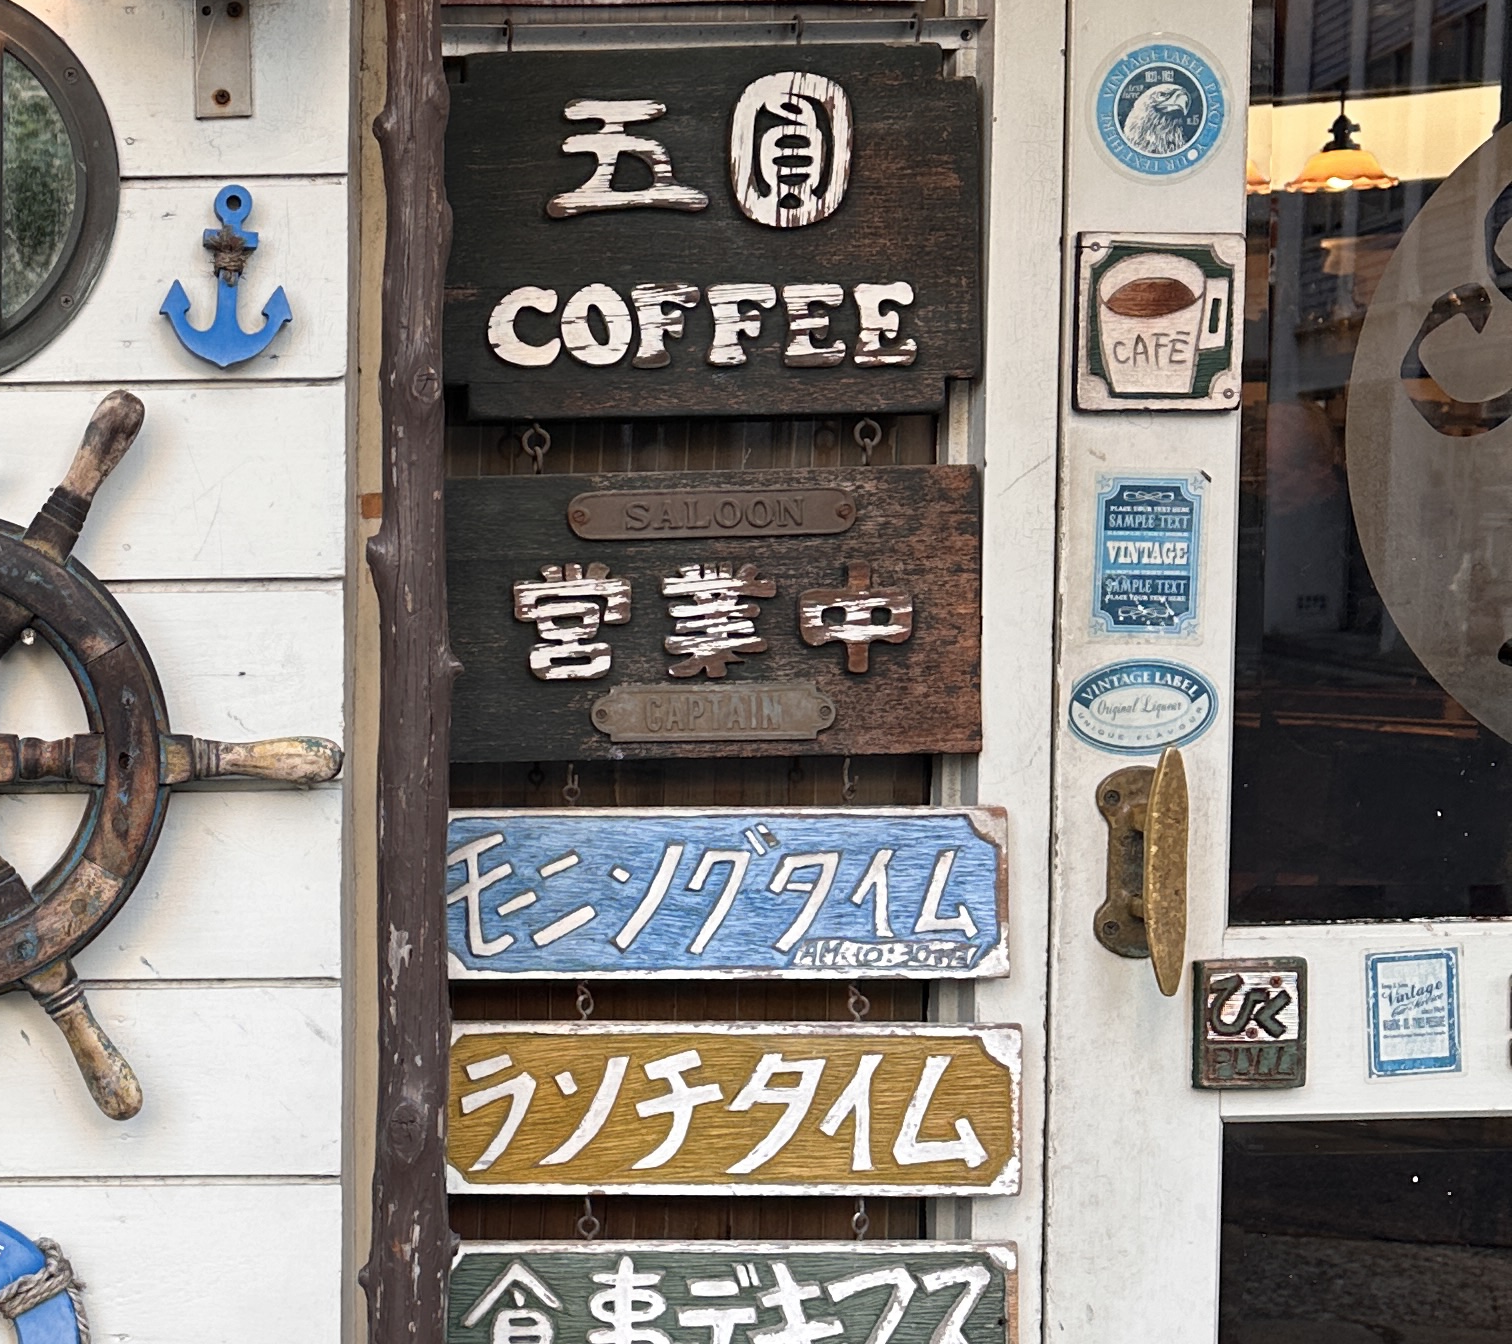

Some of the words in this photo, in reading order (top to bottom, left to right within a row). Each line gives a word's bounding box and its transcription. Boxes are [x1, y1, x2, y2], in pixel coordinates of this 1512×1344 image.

[1102, 50, 1160, 99] VINTAGE
[1164, 49, 1205, 78] LABEL
[1165, 142, 1208, 171] YUR
[487, 281, 919, 370] COFFEE
[624, 496, 805, 533] SALOON
[1108, 513, 1156, 529] SAMPLE
[1159, 514, 1191, 529] TEXT
[1106, 541, 1189, 566] VINTAGE
[1154, 579, 1188, 594] TEXT
[513, 560, 915, 680] 営業中
[1081, 671, 1151, 700] VINTAGE
[1154, 671, 1200, 698] LABEL
[644, 694, 784, 732] CAPTAIN
[1077, 712, 1125, 741] UNIQUE
[1136, 706, 1204, 741] FLAVOUR
[1097, 695, 1139, 721] Original
[448, 823, 979, 957] モーニングタイム
[1209, 973, 1292, 1039] ひく
[1381, 980, 1444, 1006] Vintage
[1208, 1045, 1296, 1078] PULL
[460, 1049, 990, 1174] ランチタイム
